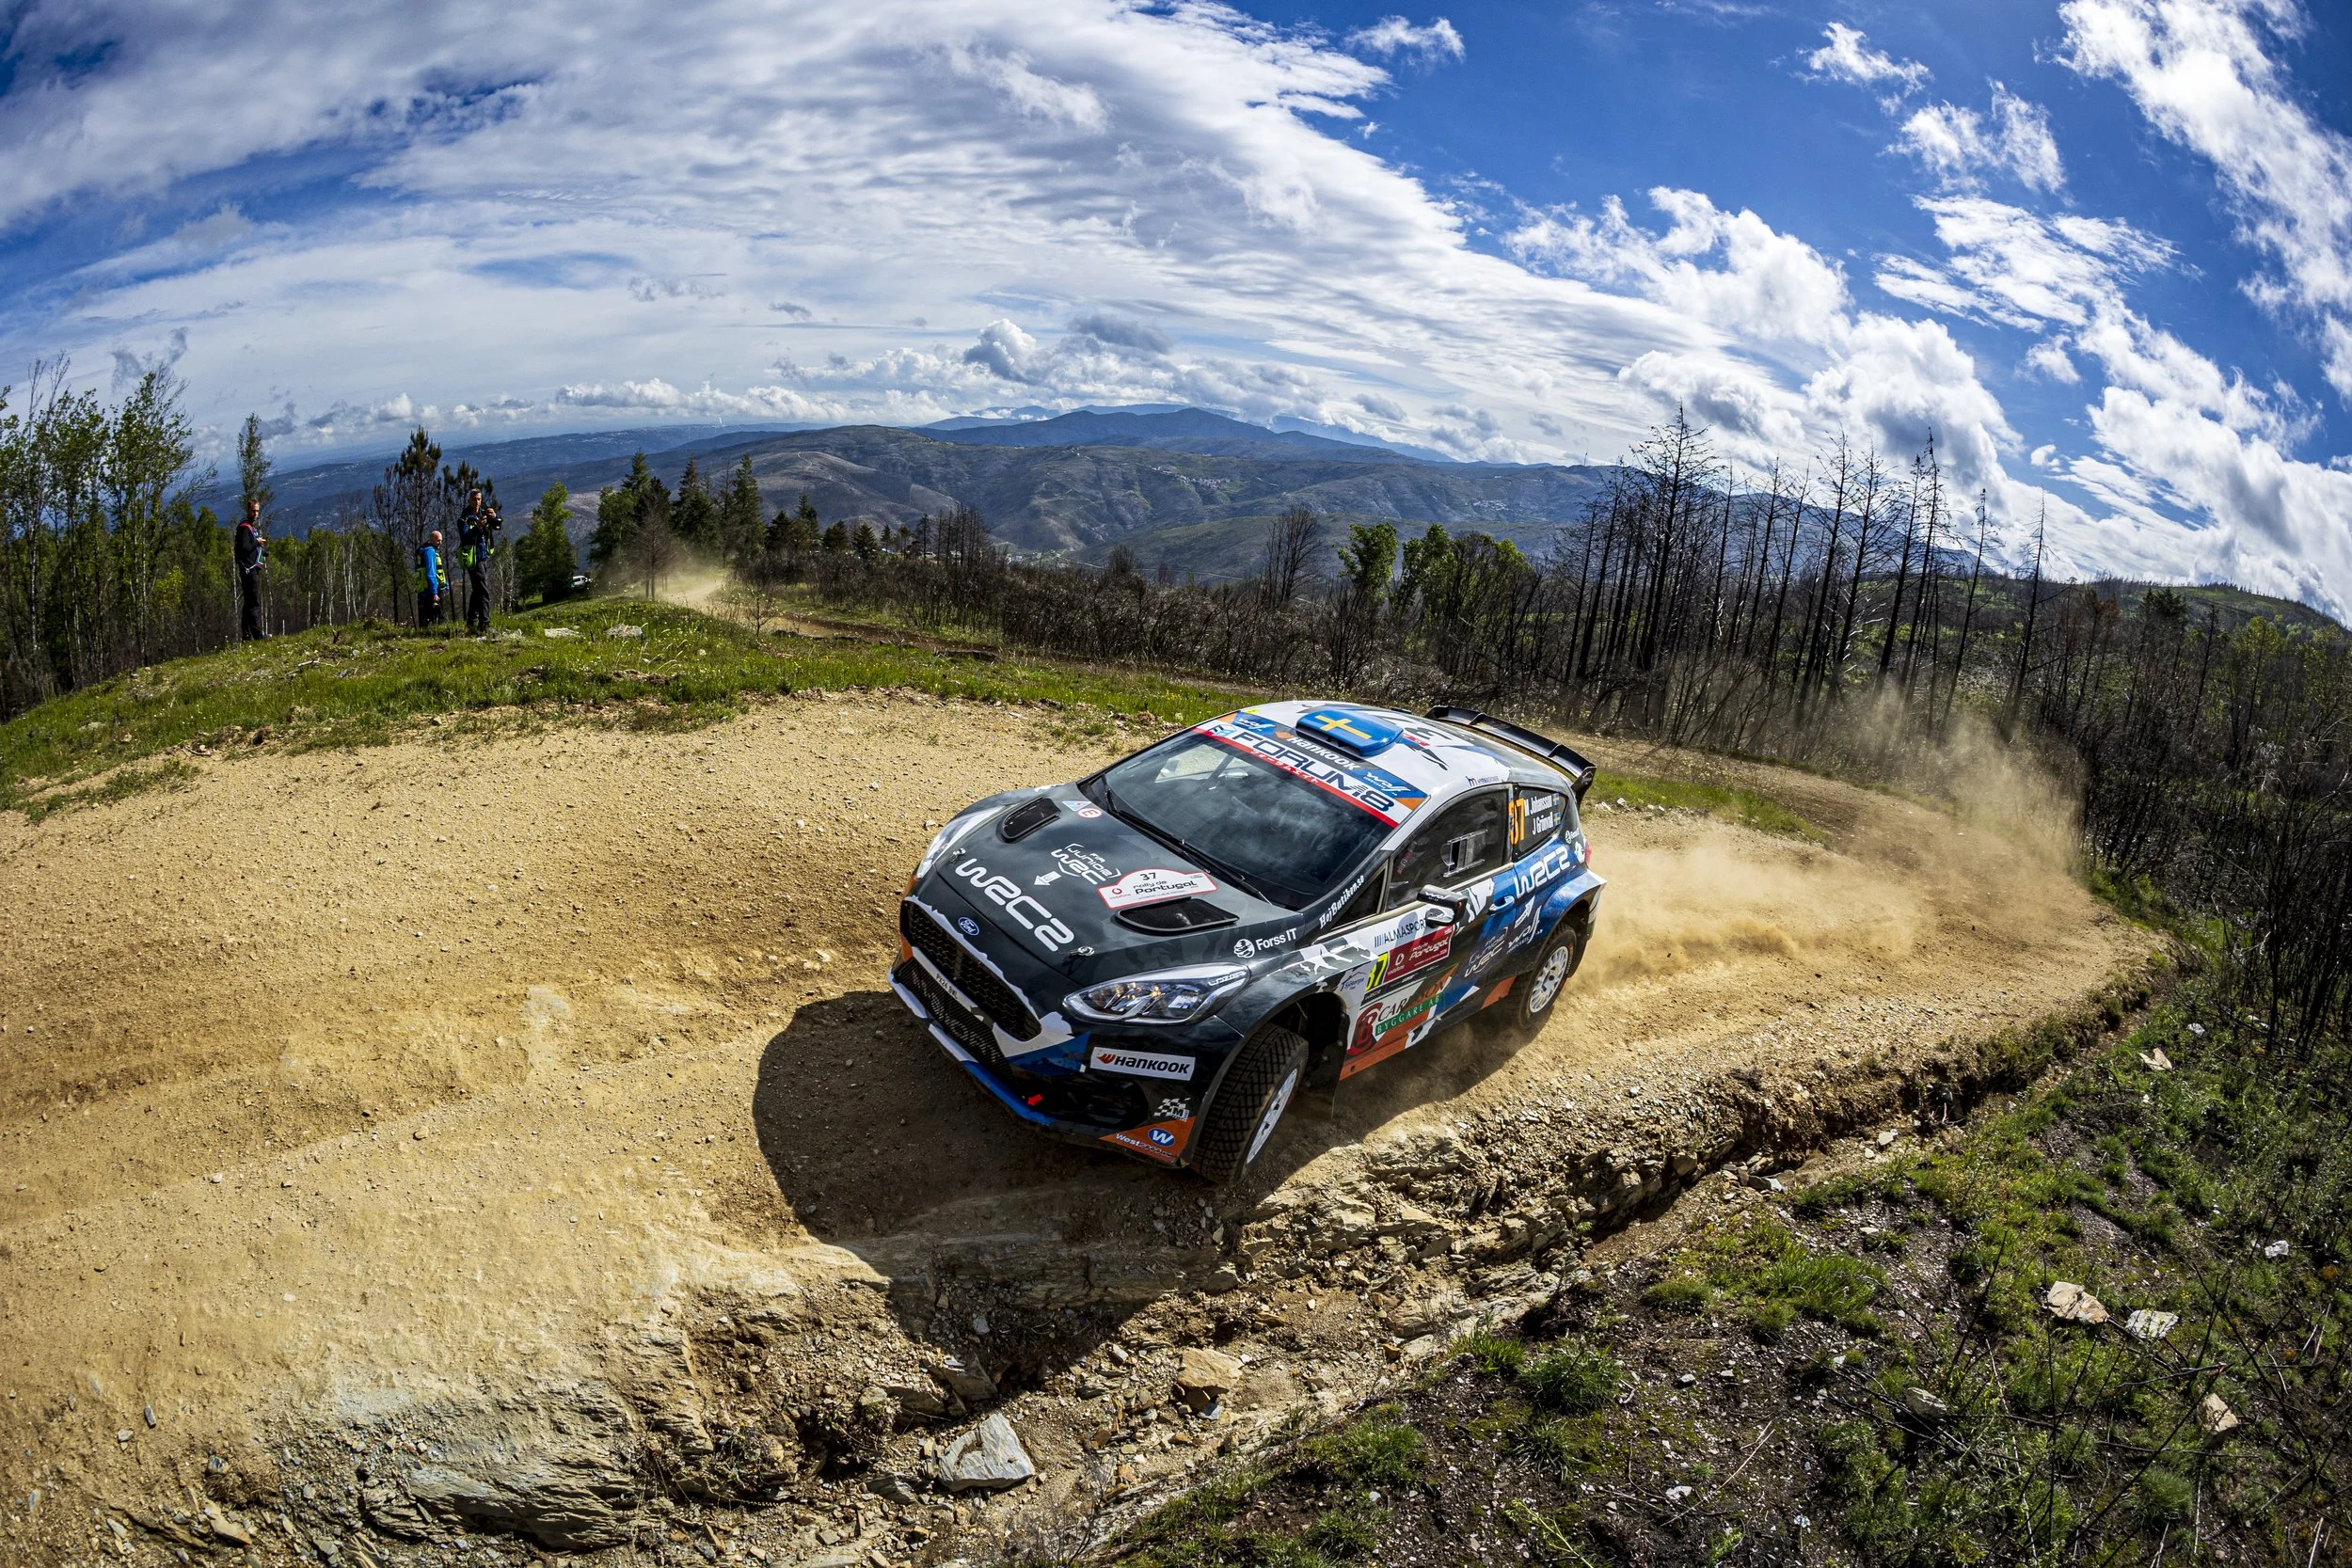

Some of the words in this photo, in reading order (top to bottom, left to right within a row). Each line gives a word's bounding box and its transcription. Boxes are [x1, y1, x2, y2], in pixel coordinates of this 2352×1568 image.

[1232, 731, 1395, 812] FORUM8
[1530, 794, 1553, 815] Johansson
[1509, 798, 1524, 846] 37
[1532, 817, 1536, 835] J
[1135, 880, 1198, 895] Portugal
[1139, 872, 1156, 881] 37
[960, 919, 977, 934] Ford
[1255, 934, 1286, 951] Forss
[1286, 927, 1297, 942] IT
[1408, 937, 1449, 961] Portugal
[1377, 1005, 1423, 1034] BYGGARE
[1428, 995, 1440, 1007] AB
